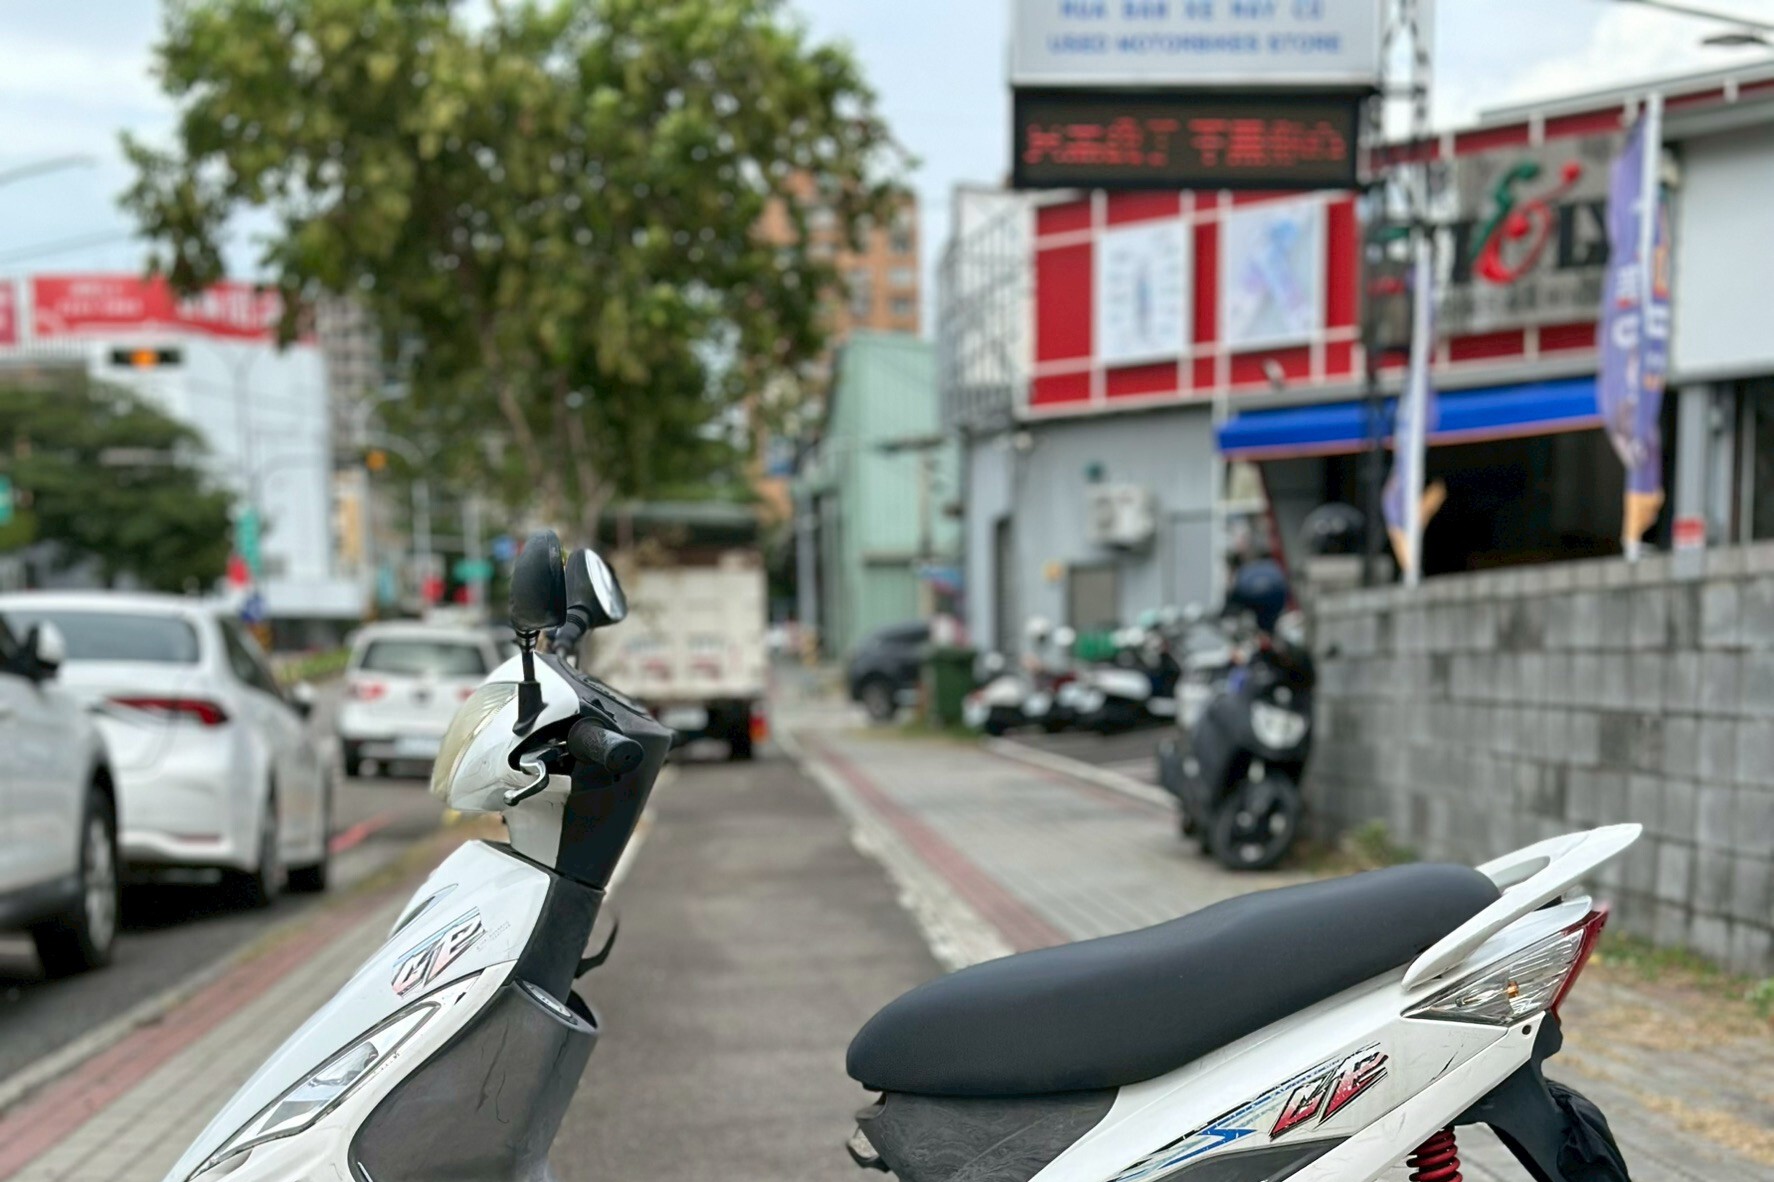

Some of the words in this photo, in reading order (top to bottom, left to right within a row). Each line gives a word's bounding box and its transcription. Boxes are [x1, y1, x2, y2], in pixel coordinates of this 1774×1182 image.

[1049, 32, 1109, 54] USED
[1118, 32, 1259, 54] MOTORBIKES
[1267, 32, 1342, 54] STORE
